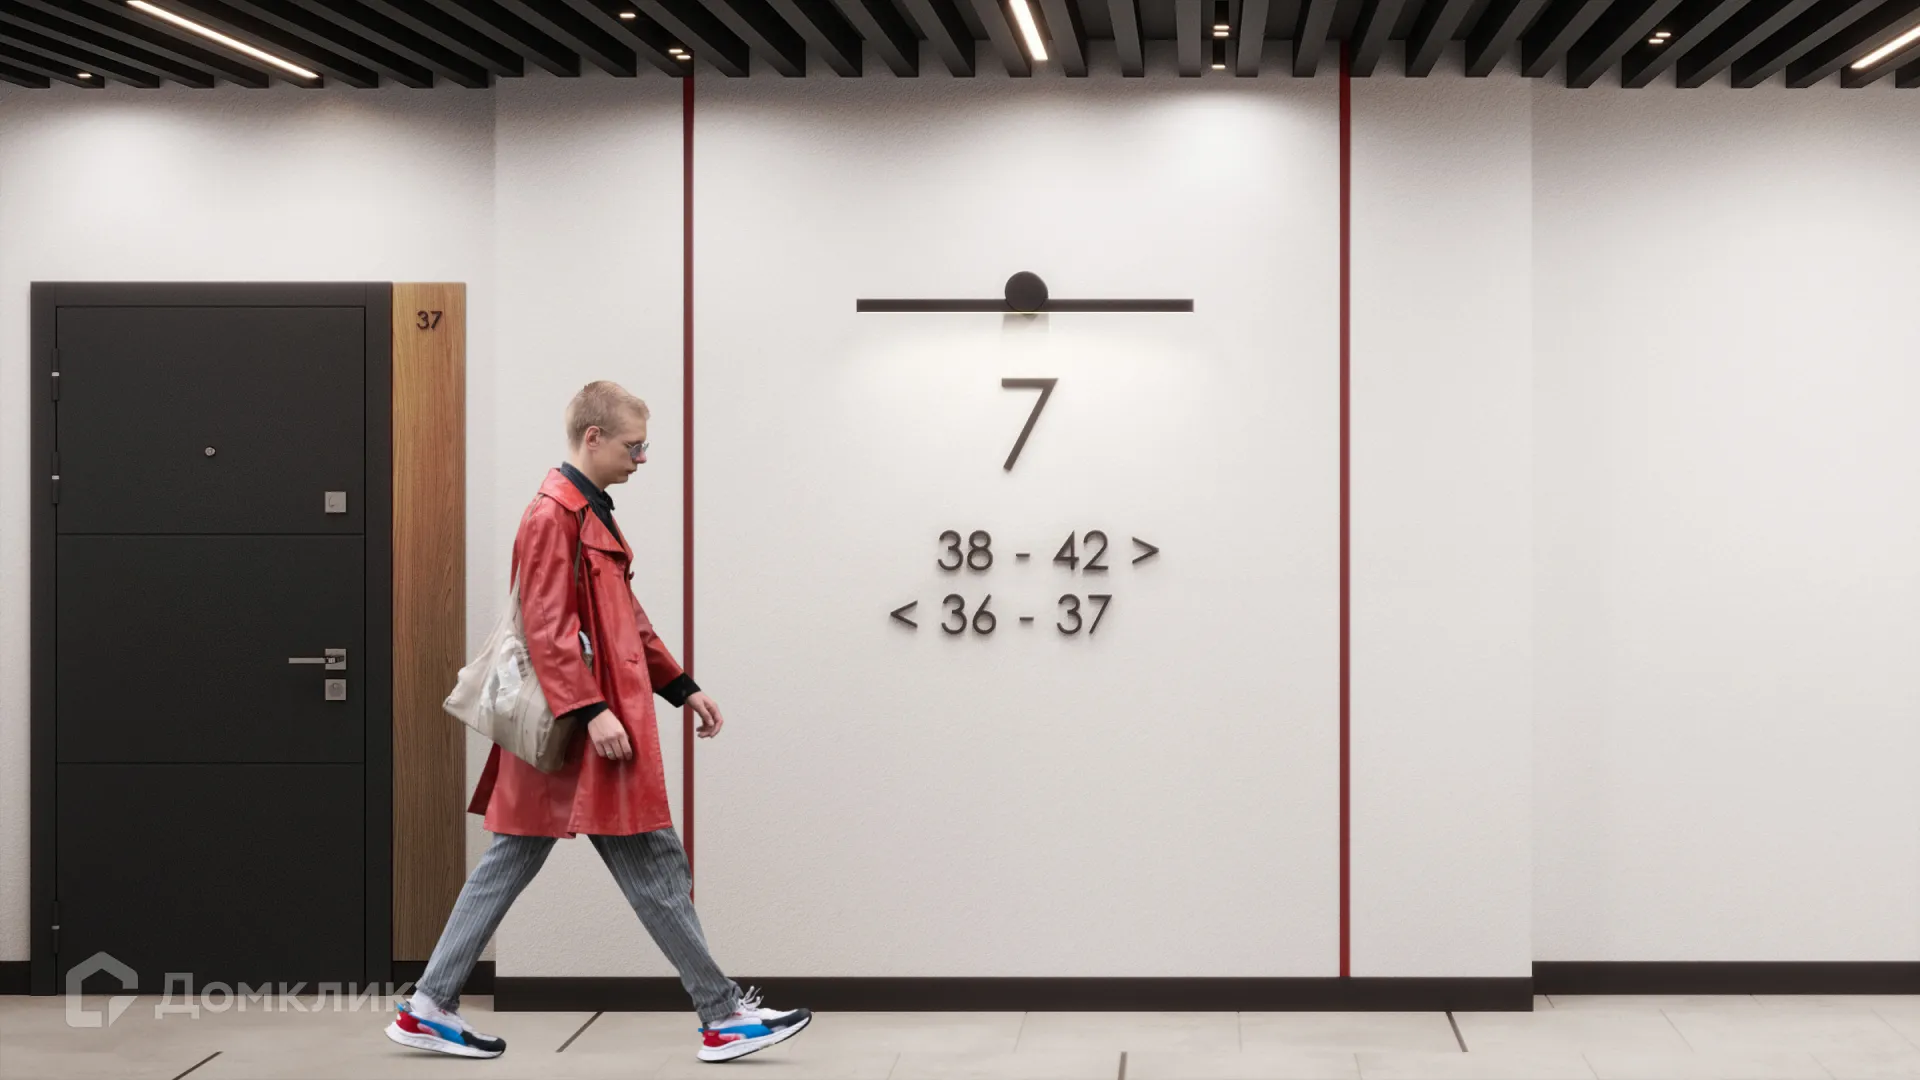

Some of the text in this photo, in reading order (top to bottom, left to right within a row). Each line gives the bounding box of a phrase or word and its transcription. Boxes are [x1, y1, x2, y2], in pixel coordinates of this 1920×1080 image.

[416, 310, 443, 330] 37
[1001, 378, 1058, 472] 7
[937, 529, 994, 572] 38
[1052, 529, 1109, 572] 42
[941, 593, 997, 636] 36
[1056, 593, 1113, 636] 37
